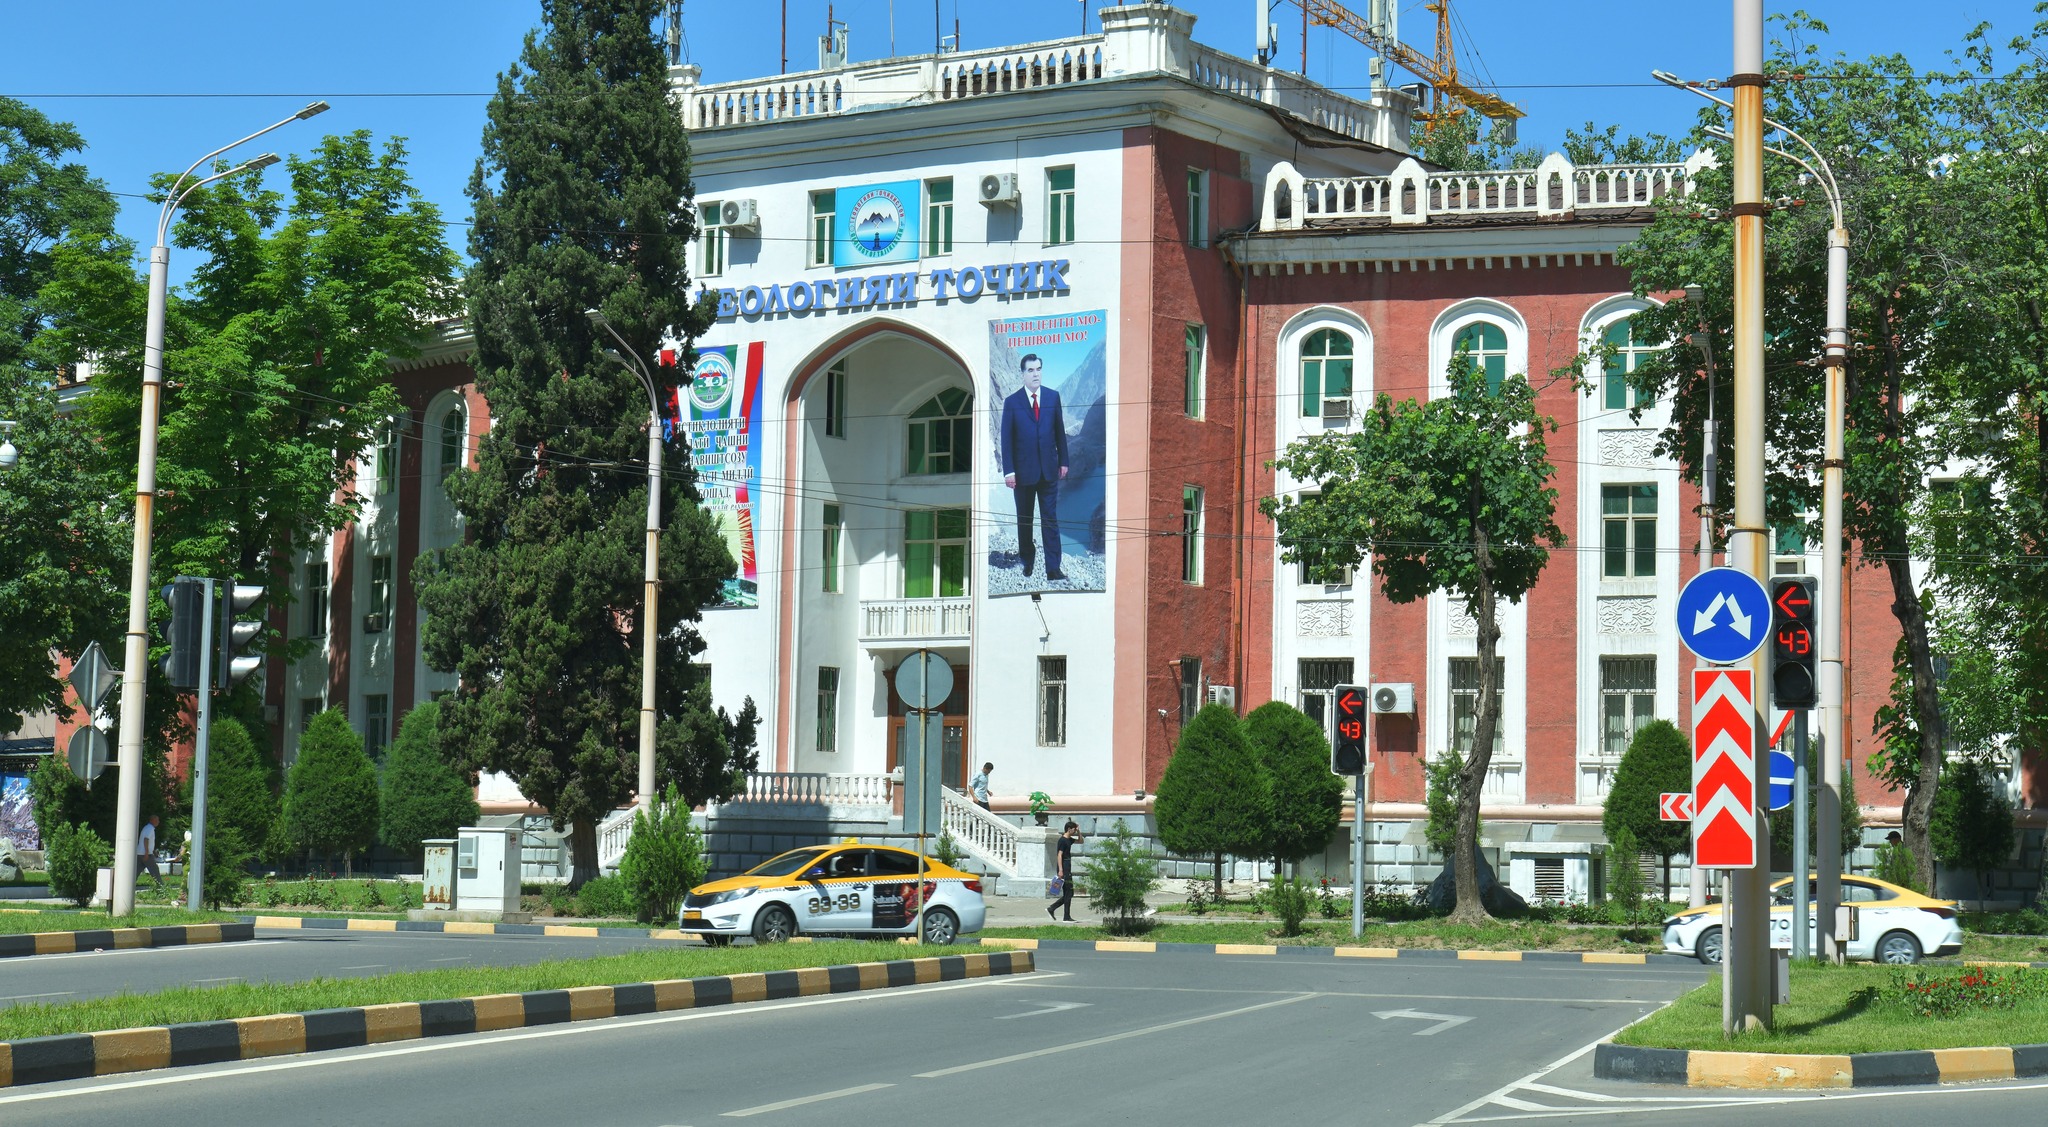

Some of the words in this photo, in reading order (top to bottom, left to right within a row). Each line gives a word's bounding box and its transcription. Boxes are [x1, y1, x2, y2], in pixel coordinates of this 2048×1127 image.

[995, 317, 1074, 334] ПРЕЗИДЕНТИ
[1064, 331, 1088, 343] МО!
[1778, 630, 1809, 654] 43
[1340, 721, 1361, 739] 43
[808, 892, 861, 914] 33-33
